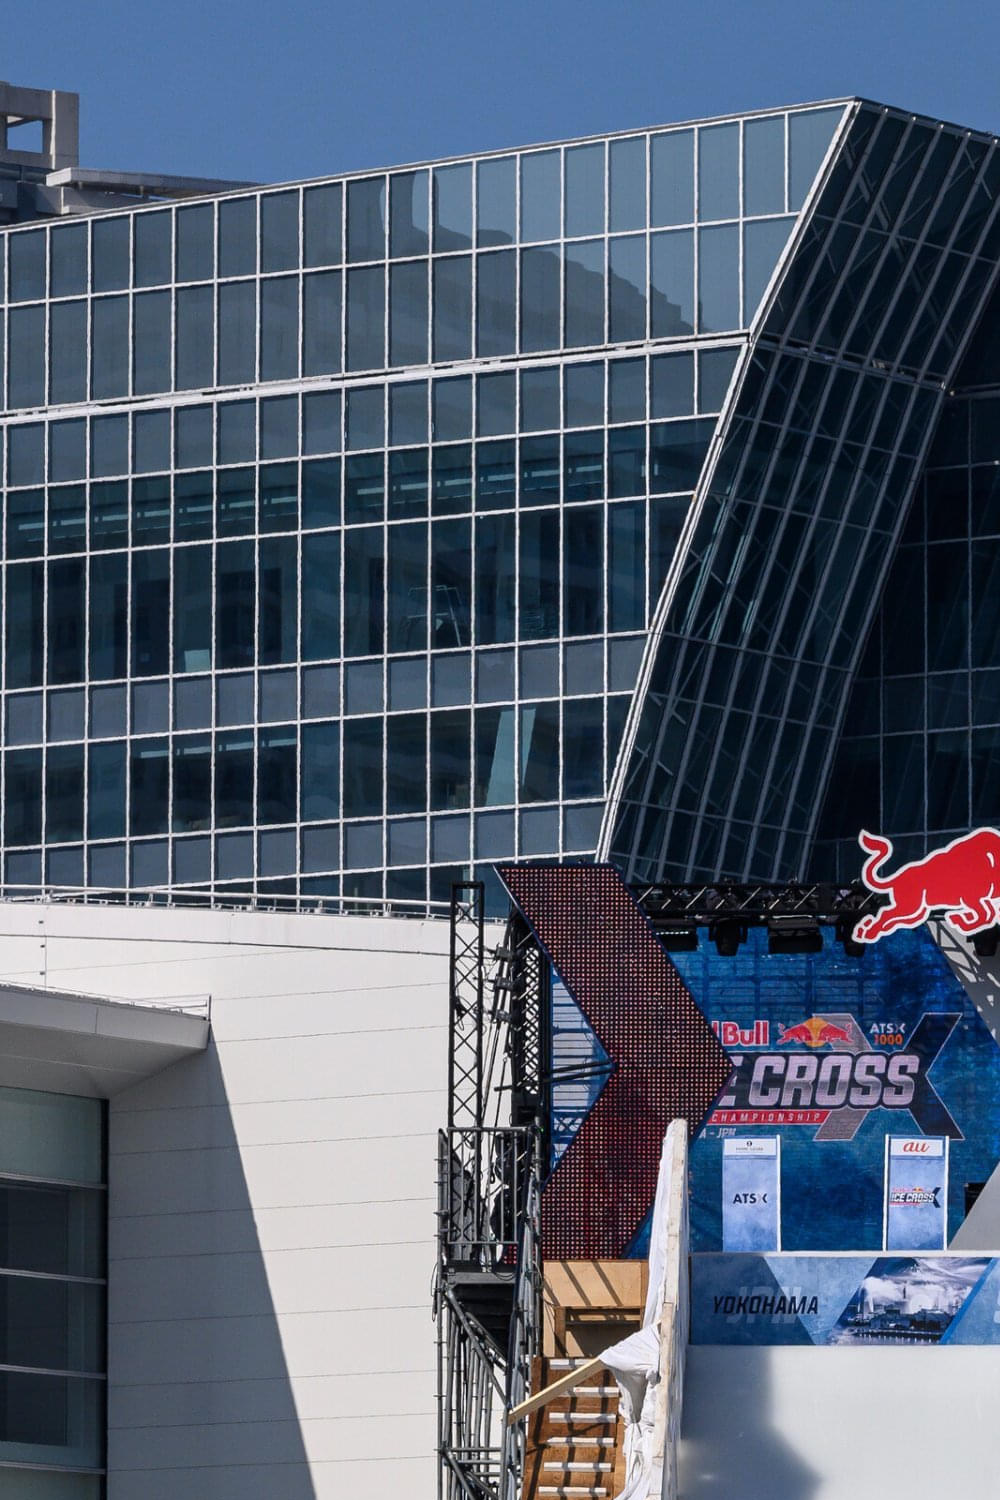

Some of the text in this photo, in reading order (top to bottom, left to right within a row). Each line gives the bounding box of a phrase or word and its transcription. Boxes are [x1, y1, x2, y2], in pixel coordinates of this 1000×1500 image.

[722, 1021, 770, 1046] Bull
[874, 1032, 903, 1045] 1000
[749, 1055, 920, 1106] CROSS
[711, 1112, 821, 1123] CHAMPIONSHIP
[903, 1142, 930, 1152] au
[713, 1296, 819, 1315] YOKOHAMA
